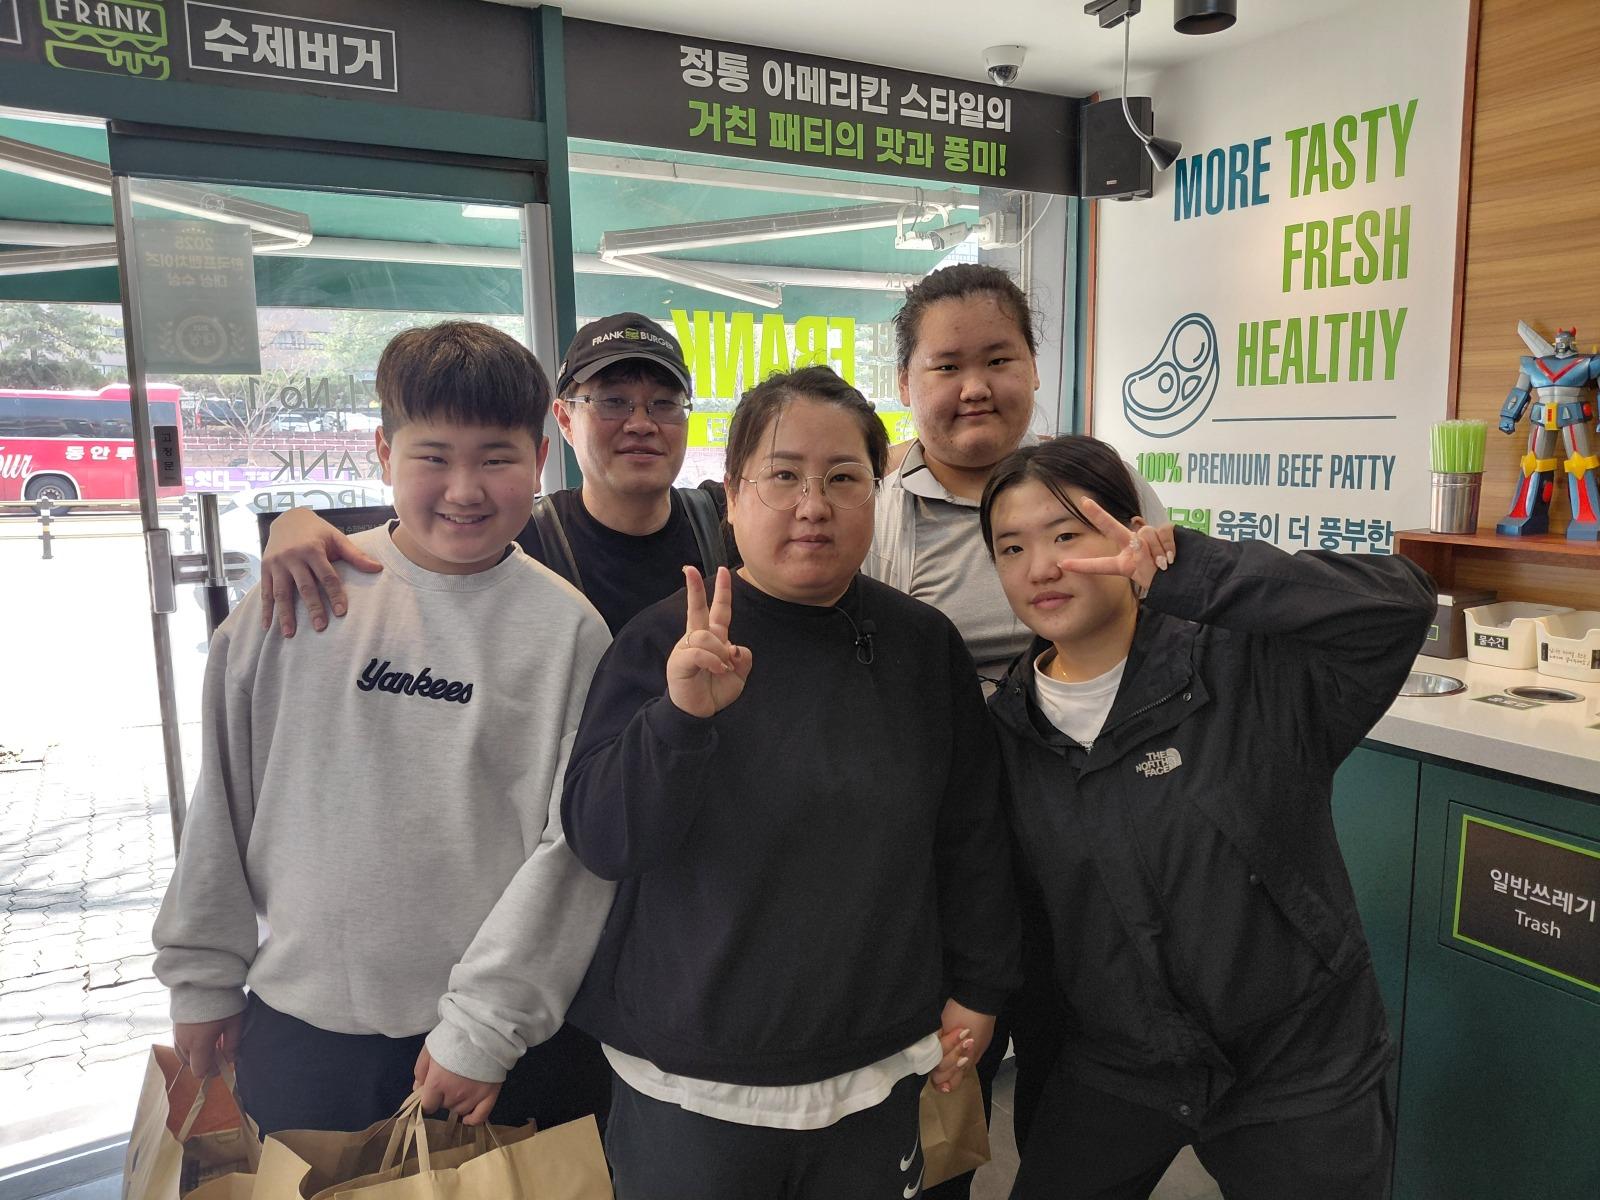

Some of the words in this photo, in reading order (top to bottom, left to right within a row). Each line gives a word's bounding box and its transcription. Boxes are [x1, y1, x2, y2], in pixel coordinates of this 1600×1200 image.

[55, 0, 153, 34] FRANK
[204, 18, 382, 80] 수제버거
[680, 45, 750, 93] 정통
[762, 60, 891, 115] 아메리칸
[900, 83, 1012, 133] 스타일의
[689, 100, 757, 146] 거친
[769, 111, 865, 160] 패티의
[876, 126, 935, 168] 맛과
[943, 136, 1008, 177] 풍미!
[1174, 136, 1272, 222] MORE
[1285, 98, 1419, 198] TASTY
[1282, 205, 1411, 293] FRESH
[592, 330, 625, 347] FRANK
[640, 331, 674, 352] BURGER
[1236, 307, 1408, 387] HEALTHY
[1136, 452, 1182, 483] 100%
[1187, 453, 1271, 486] PREMIUM
[1277, 454, 1323, 488] BEEF
[1329, 455, 1396, 491] PATTY
[1216, 510, 1280, 545] 육즙이
[1289, 515, 1310, 548] 더
[1318, 516, 1394, 555] 풍부한
[1479, 635, 1505, 649] 물수건
[356, 658, 474, 704] Yankees
[1135, 757, 1169, 773] NORTH
[1144, 766, 1171, 778] FACE
[1145, 751, 1168, 760] THE
[1490, 869, 1596, 923] 일반쓰레기
[1514, 908, 1561, 939] Trash
